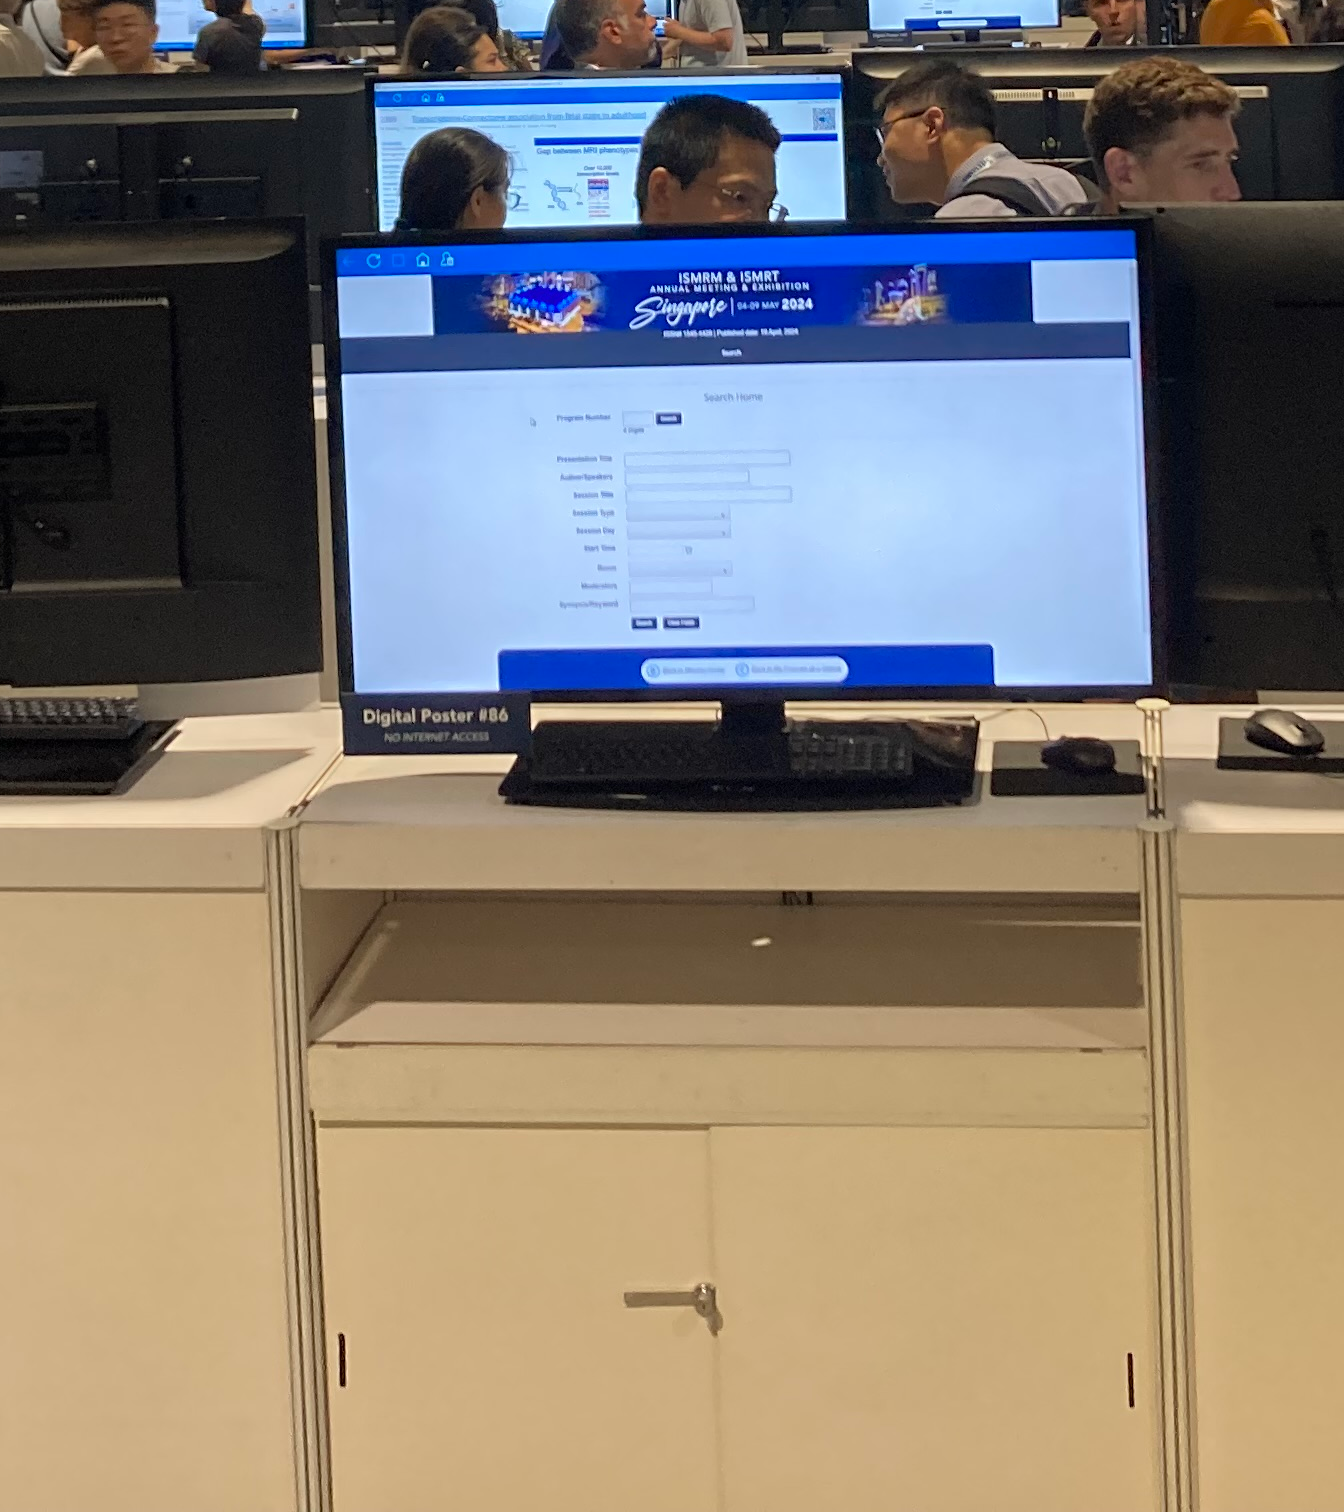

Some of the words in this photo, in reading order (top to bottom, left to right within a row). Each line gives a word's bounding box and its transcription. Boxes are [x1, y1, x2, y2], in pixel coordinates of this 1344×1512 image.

[679, 272, 722, 284] ISMRM
[726, 271, 736, 283] &
[740, 270, 780, 282] ISMRT
[650, 285, 690, 293] ANNUAL
[694, 284, 738, 292] MEETING
[752, 282, 810, 291] EXHIBITION
[629, 296, 728, 330] Singapore
[762, 300, 779, 309] MAY
[782, 298, 813, 310] 2024
[704, 393, 733, 402] Search
[736, 393, 763, 402] Home
[363, 707, 416, 728] Digital
[421, 708, 475, 723] Poster
[479, 706, 509, 723] #86
[384, 732, 400, 742] NO
[403, 731, 450, 742] INTERNET
[452, 731, 490, 742] ACCESS
